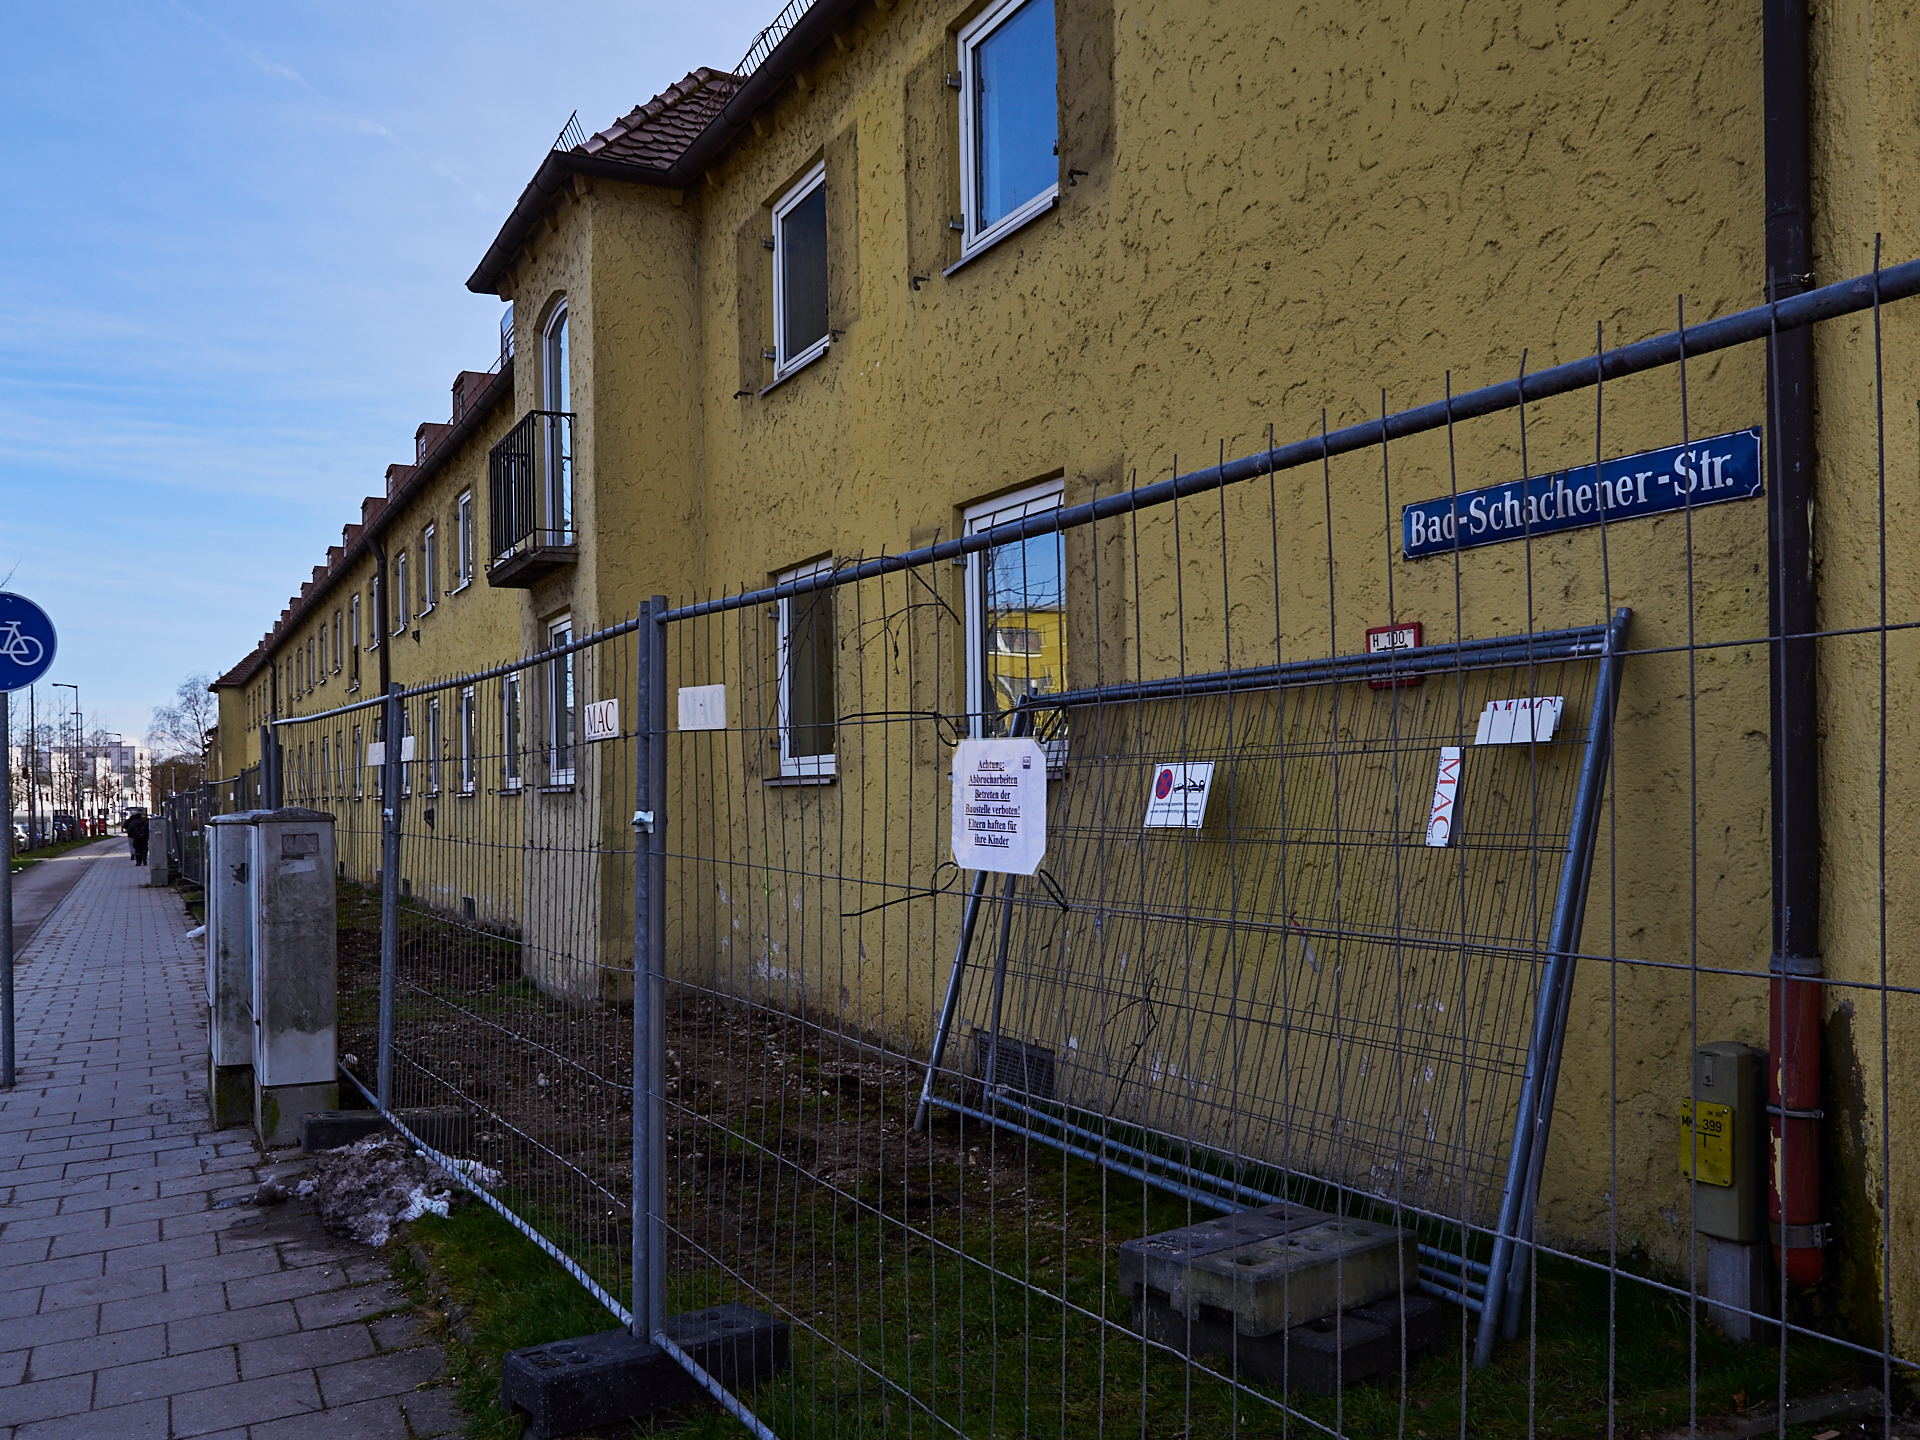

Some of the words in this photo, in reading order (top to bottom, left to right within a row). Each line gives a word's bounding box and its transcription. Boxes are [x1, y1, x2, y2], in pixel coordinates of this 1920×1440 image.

[1410, 449, 1734, 546] Bad-Schachener-Str.
[1372, 634, 1379, 647] H
[1386, 630, 1404, 646] 100
[587, 701, 615, 735] MAC
[978, 760, 1004, 770] Achtung:
[969, 774, 1018, 784] Abbrucharbeiten
[975, 788, 999, 798] Betreten
[1000, 789, 1010, 799] der
[1430, 756, 1460, 839] MAC
[965, 803, 990, 814] Baustelle
[992, 804, 1020, 815] verboten!
[968, 818, 986, 829] Eltern
[987, 819, 1006, 830] haften
[1007, 820, 1018, 831] für
[974, 833, 987, 844] ihre
[988, 834, 1009, 846] Kinder
[1702, 1118, 1722, 1133] 399
